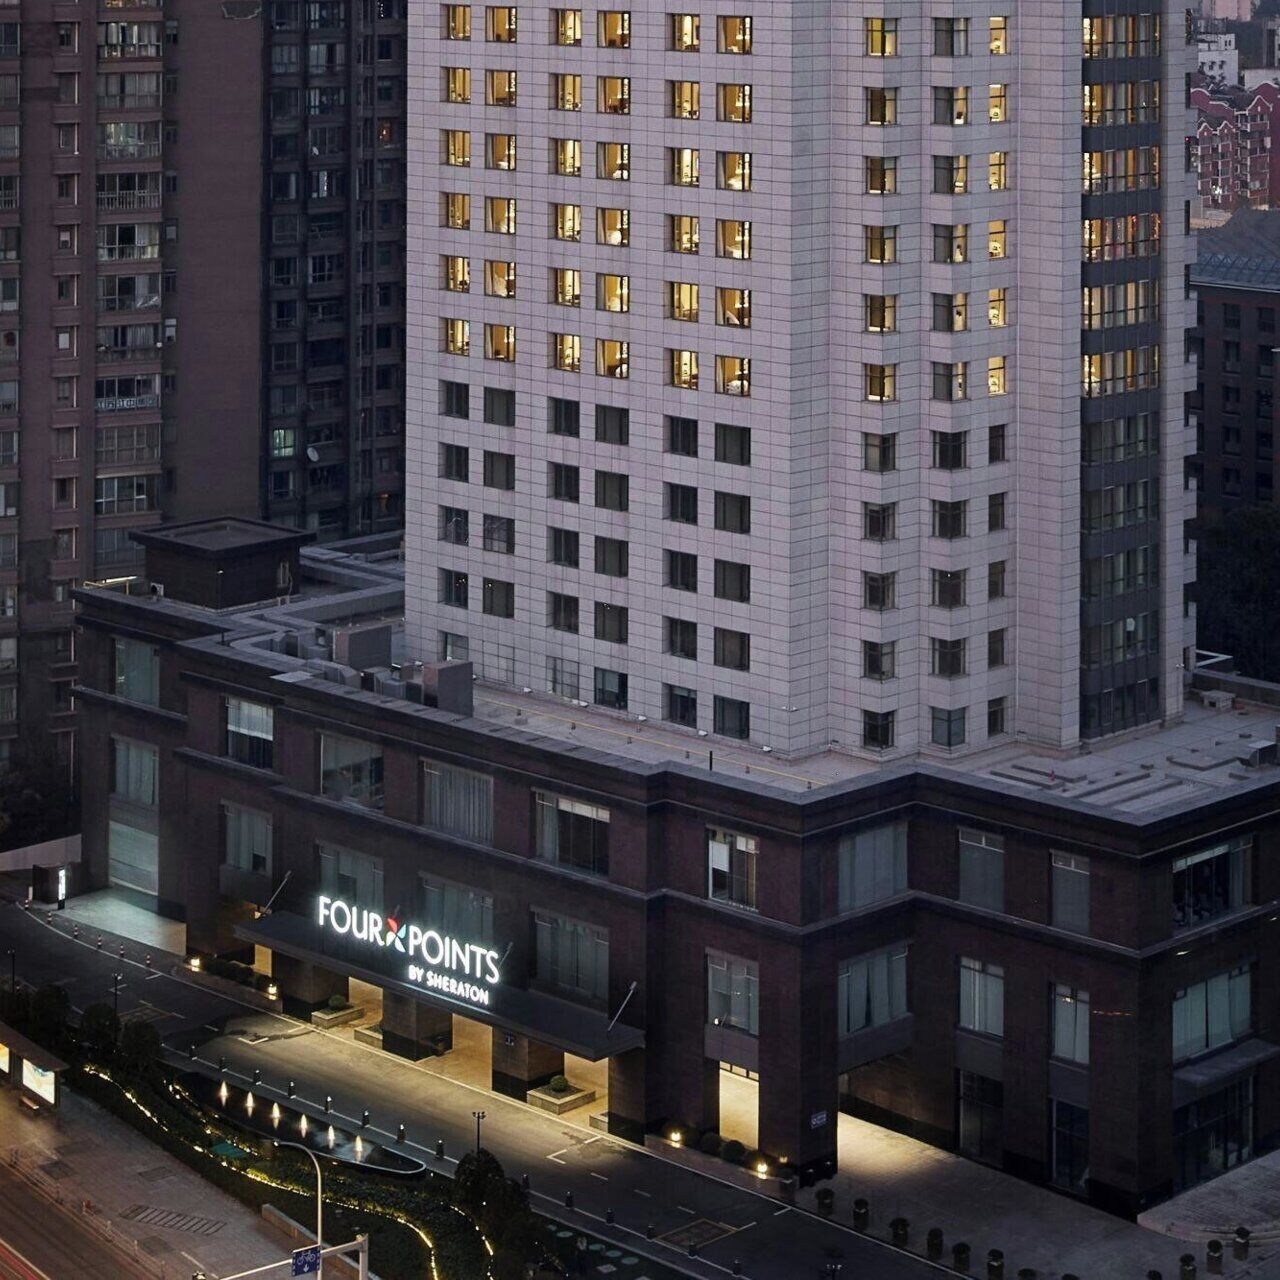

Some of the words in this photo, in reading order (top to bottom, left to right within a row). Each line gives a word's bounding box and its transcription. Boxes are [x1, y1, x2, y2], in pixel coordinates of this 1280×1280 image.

[319, 895, 386, 947] FOUR
[408, 925, 500, 984] POINTS
[408, 964, 424, 983] BY
[426, 970, 489, 1005] SHERATON
